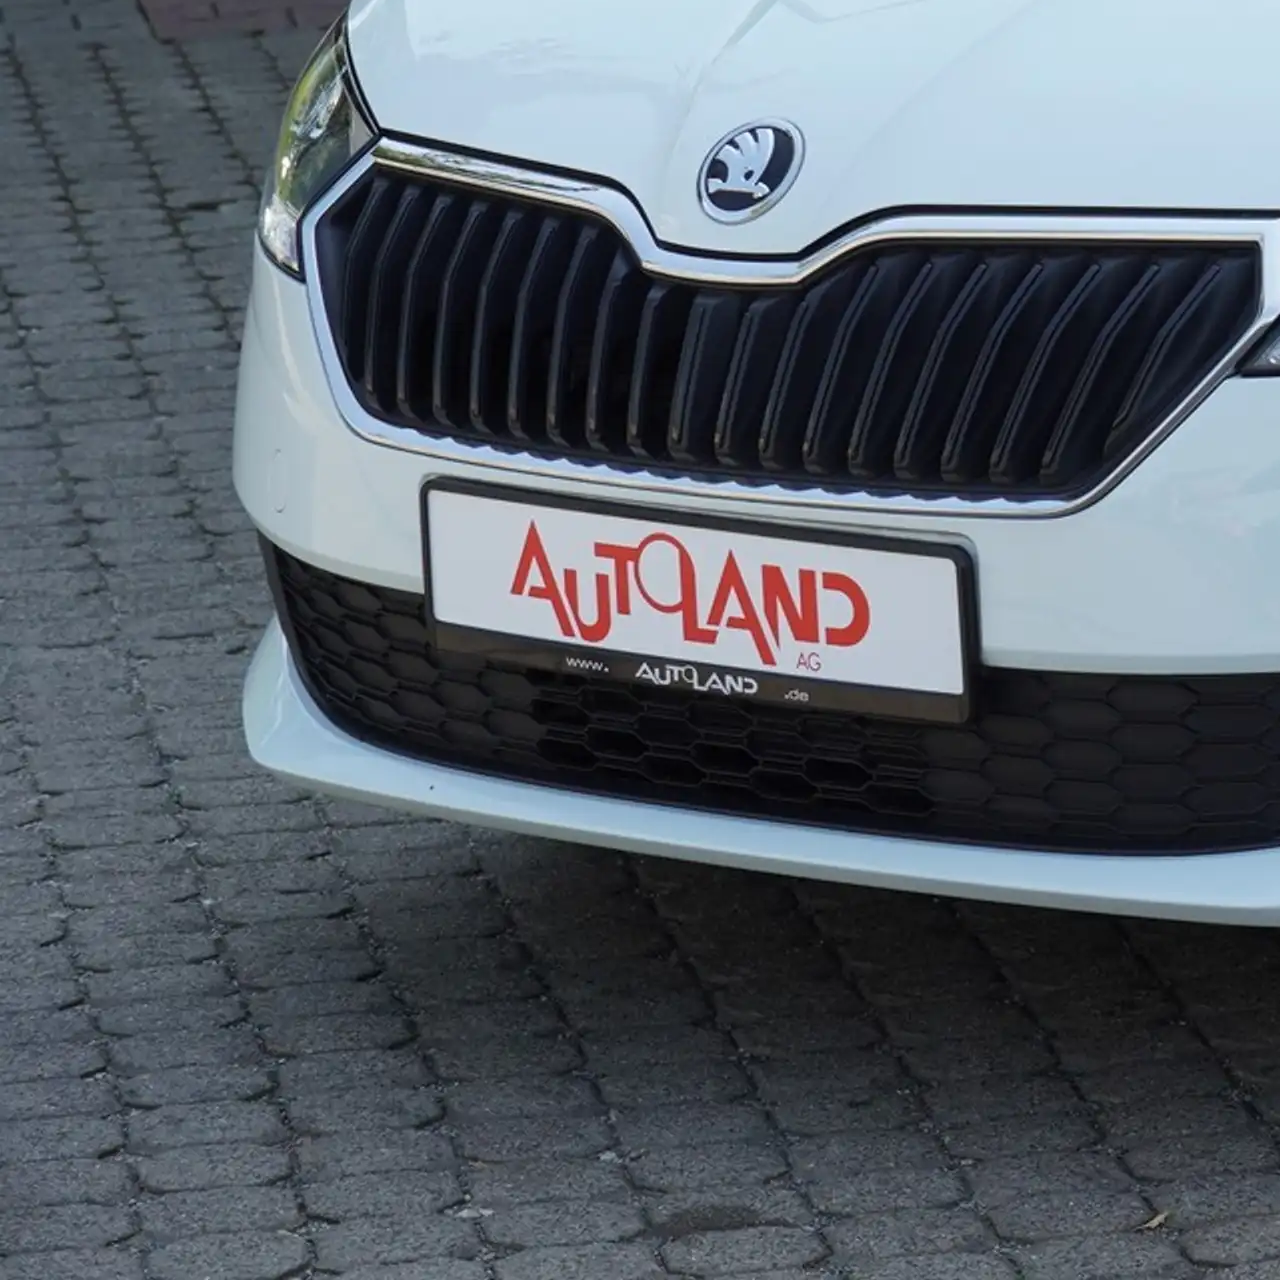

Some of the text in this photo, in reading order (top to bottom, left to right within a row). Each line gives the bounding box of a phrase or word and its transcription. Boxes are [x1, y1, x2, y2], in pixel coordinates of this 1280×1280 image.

[510, 519, 871, 666] AUTOLAND
[565, 656, 609, 673] www.
[796, 652, 821, 671] AG
